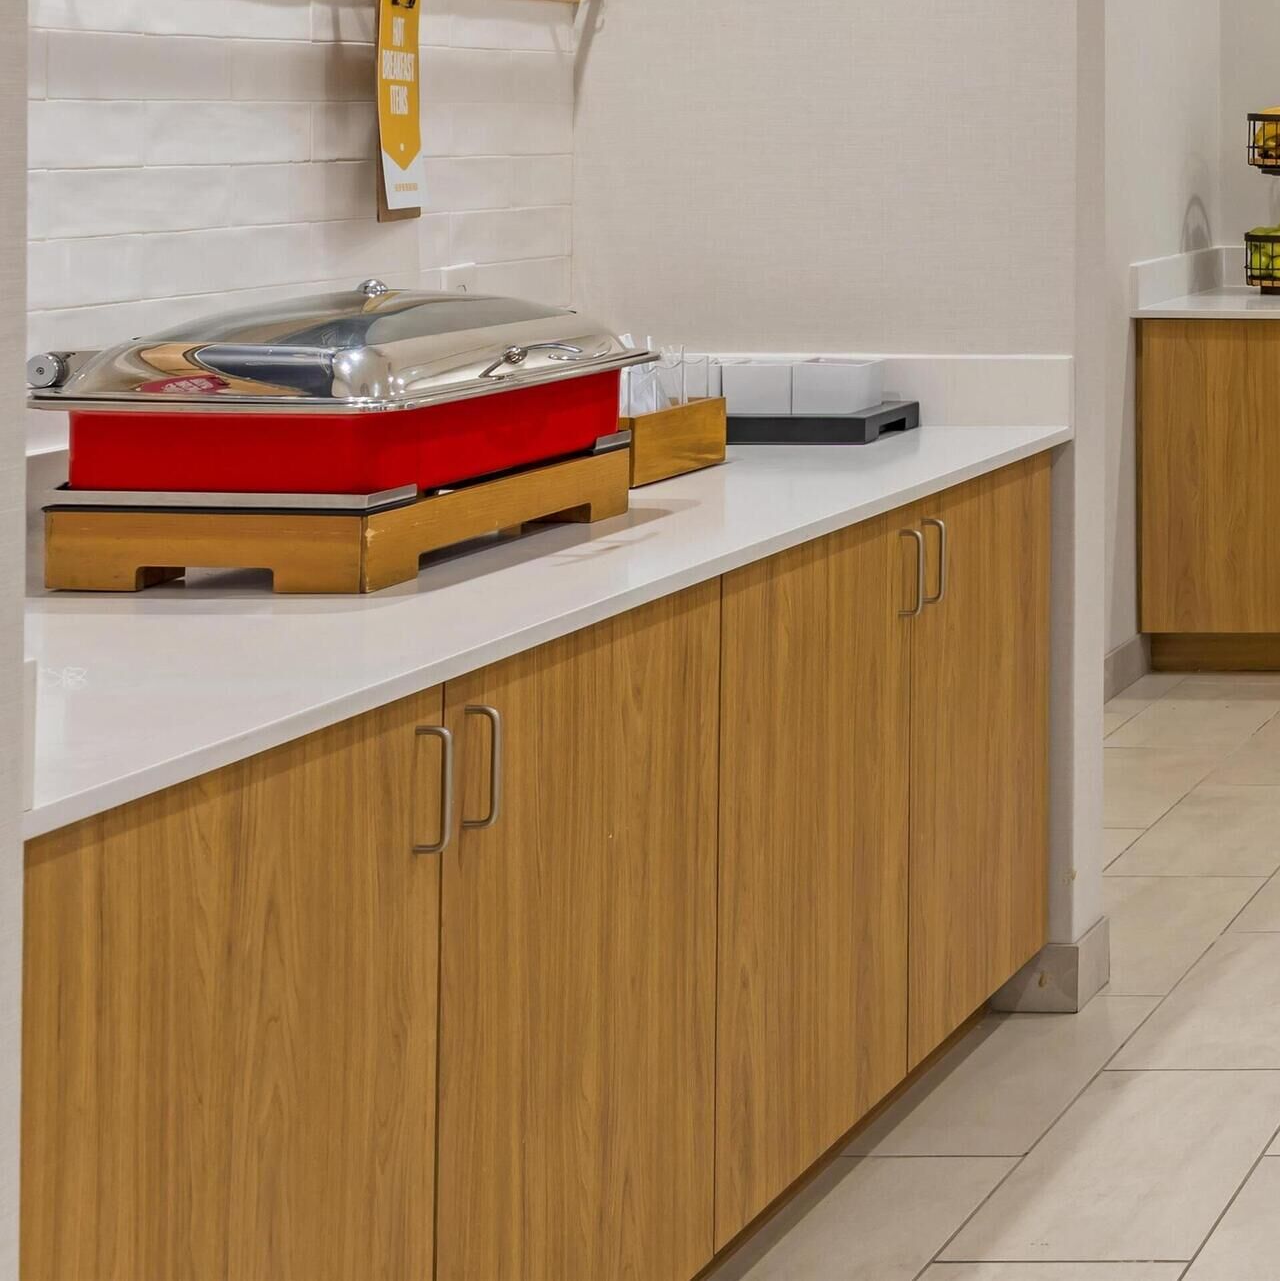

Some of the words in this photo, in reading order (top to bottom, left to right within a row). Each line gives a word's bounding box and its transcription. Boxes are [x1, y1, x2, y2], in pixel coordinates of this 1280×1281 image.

[392, 17, 405, 47] HOT
[382, 49, 415, 82] BREAKFAST
[390, 85, 409, 115] ITEMS
